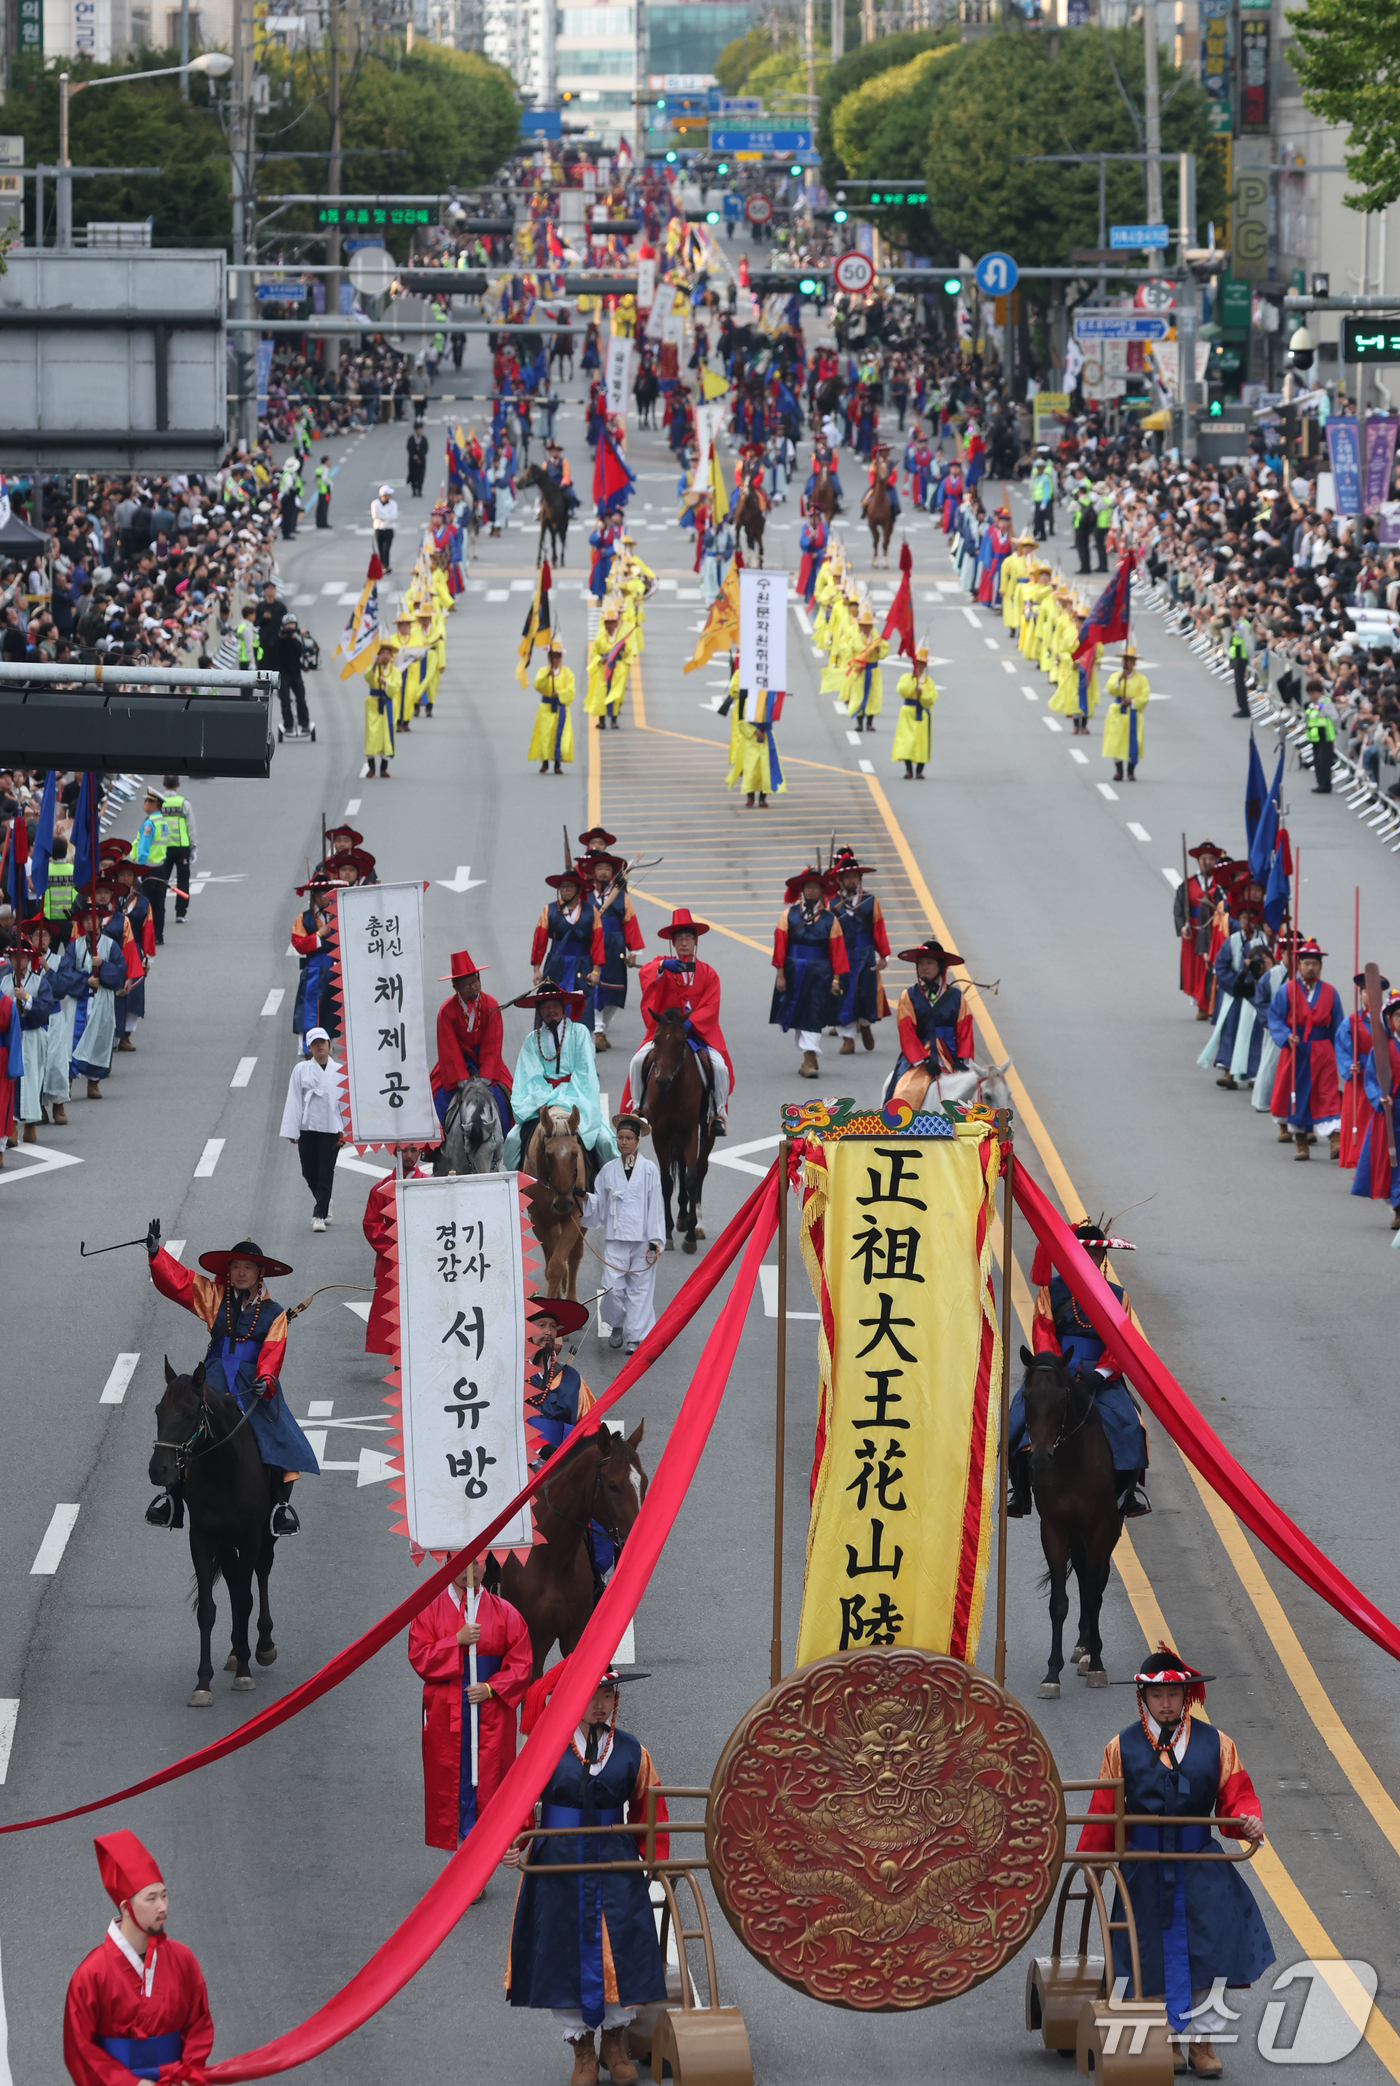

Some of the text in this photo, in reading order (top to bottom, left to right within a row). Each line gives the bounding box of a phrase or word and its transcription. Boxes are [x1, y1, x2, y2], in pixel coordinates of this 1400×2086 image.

[844, 264, 867, 280] 50
[756, 578, 771, 688] 수원문화원취타대
[365, 915, 399, 937] 총리
[367, 938, 404, 958] 대신
[374, 973, 410, 1108] 채제공
[436, 1221, 484, 1251] 경기
[437, 1253, 491, 1282] 감사
[441, 1306, 497, 1499] 서유방
[839, 1147, 928, 1652] 正祖大王花山陵
